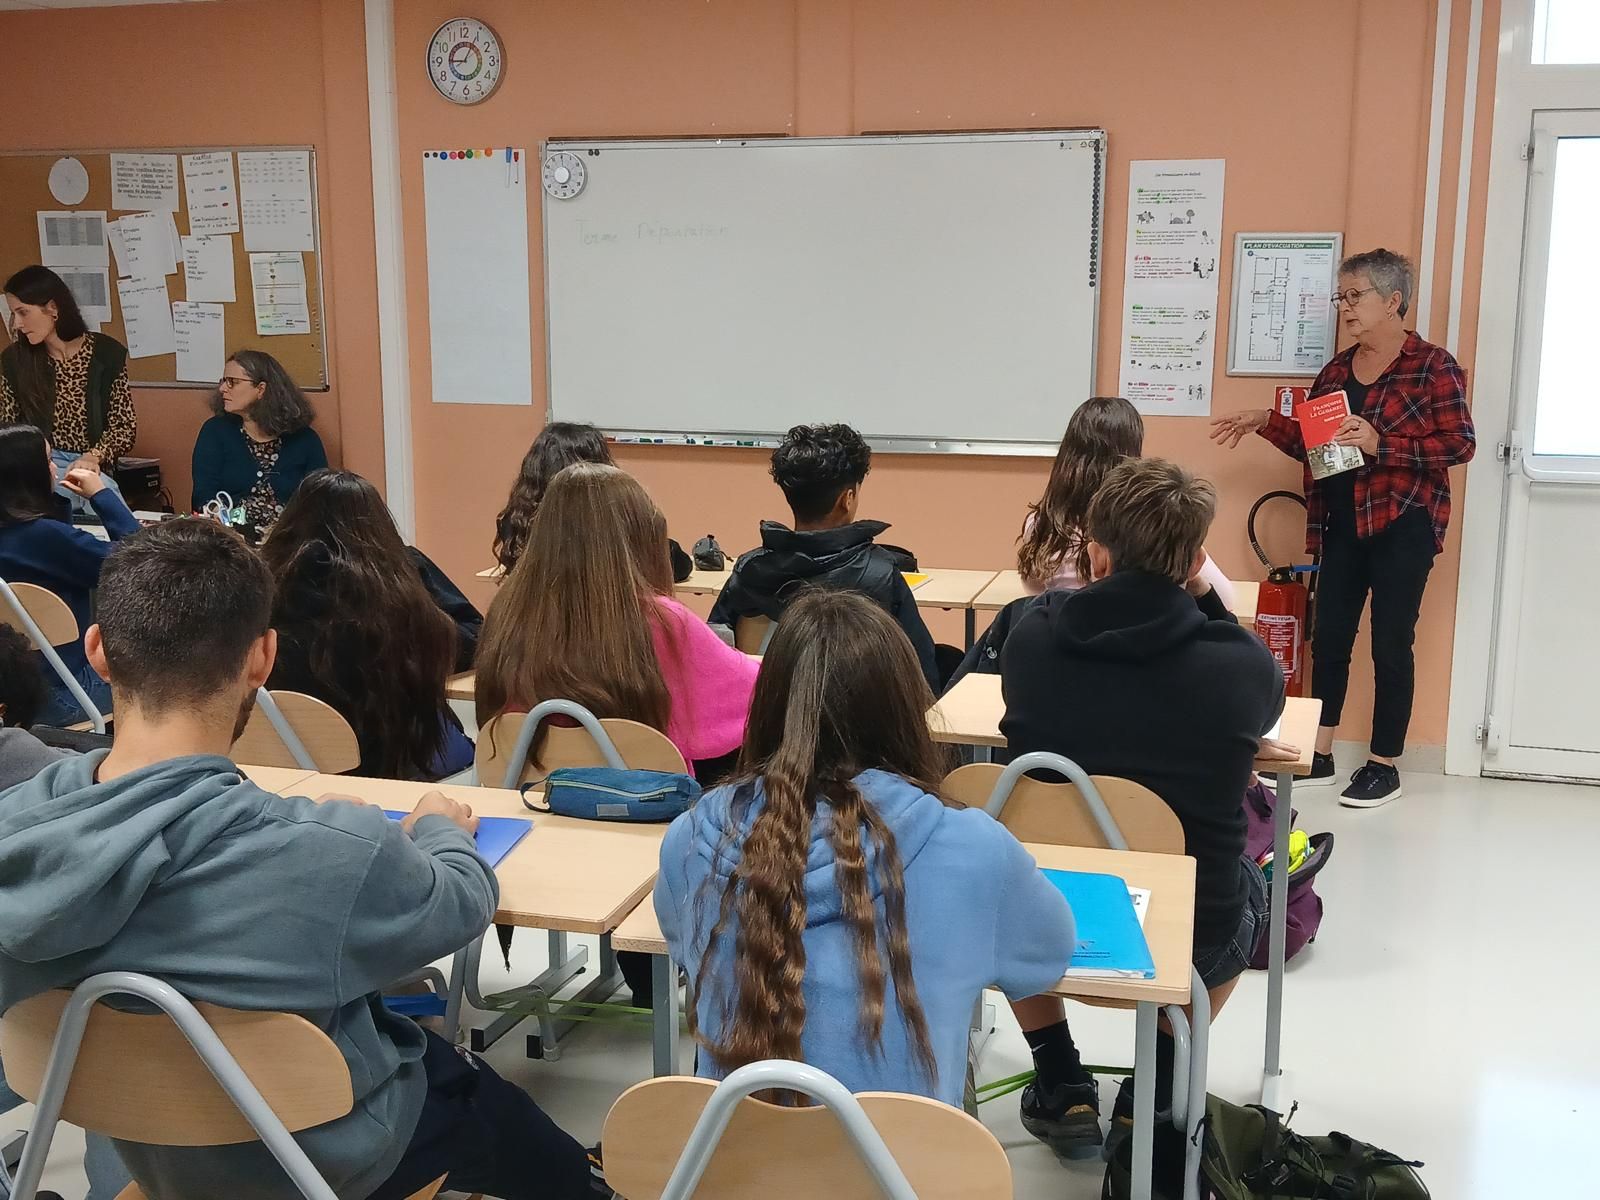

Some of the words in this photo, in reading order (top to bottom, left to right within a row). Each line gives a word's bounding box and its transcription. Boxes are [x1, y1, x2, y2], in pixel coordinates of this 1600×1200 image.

[448, 31, 456, 42] 11
[459, 27, 469, 39] 12
[439, 42, 449, 53] 10
[483, 41, 491, 53] 2
[435, 56, 443, 67] 9
[488, 55, 496, 67] 3
[440, 70, 447, 81] 8
[483, 70, 491, 80] 4
[450, 80, 457, 91] 7
[462, 84, 470, 96] 6
[475, 81, 482, 91] 5
